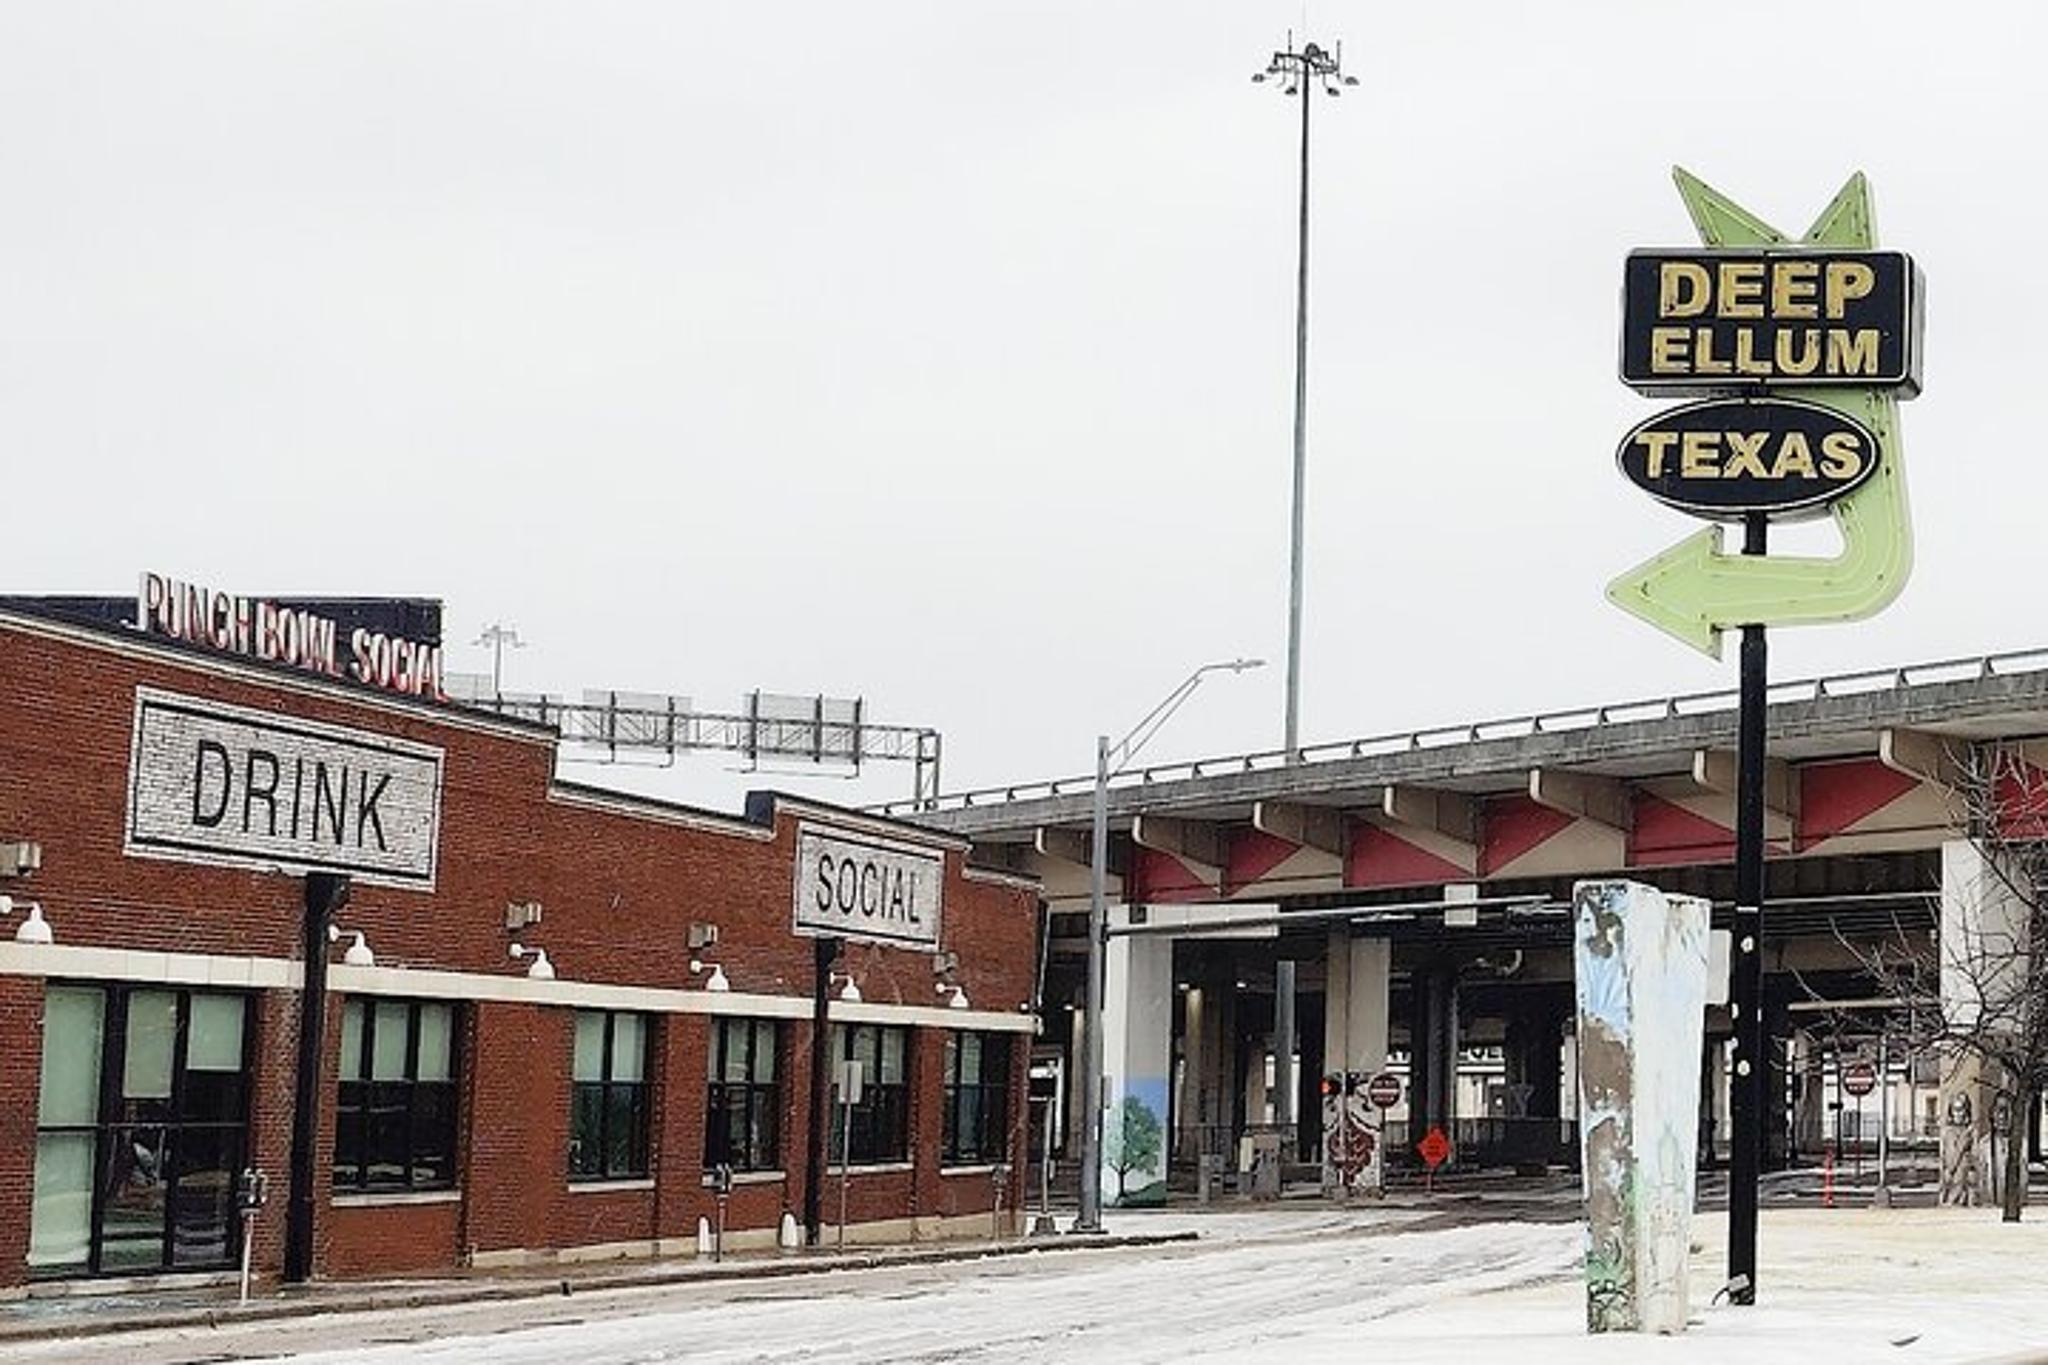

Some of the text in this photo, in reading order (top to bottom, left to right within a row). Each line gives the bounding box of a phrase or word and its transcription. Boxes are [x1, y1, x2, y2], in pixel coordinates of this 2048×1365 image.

[1659, 261, 1875, 319] DEEP
[1652, 326, 1879, 375] ELLUM
[1635, 431, 1862, 479] TEXAS
[139, 571, 449, 702] PUNCH BOWL SOCIAL
[193, 739, 392, 851] DRINK
[816, 853, 920, 923] SOCIAL
